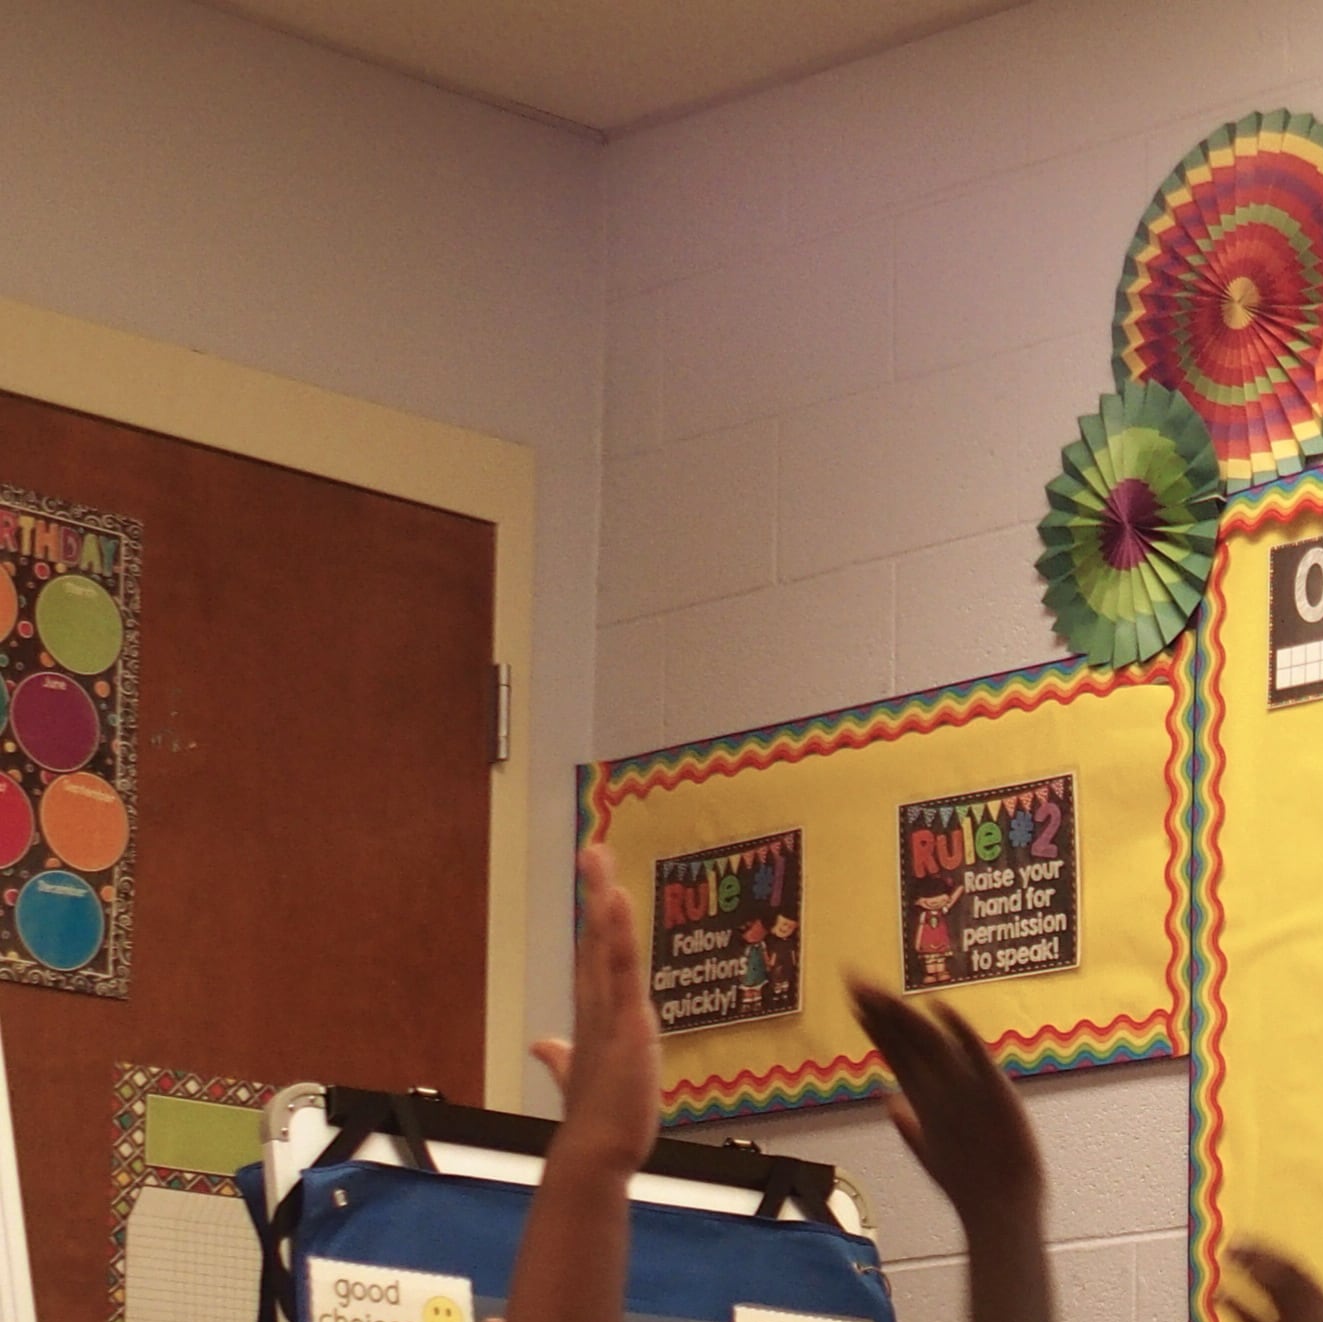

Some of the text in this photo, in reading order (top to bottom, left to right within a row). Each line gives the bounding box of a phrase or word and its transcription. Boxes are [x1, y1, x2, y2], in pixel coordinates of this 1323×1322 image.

[0, 509, 119, 577] RTHDAY
[912, 801, 1061, 878] Rule #2
[663, 854, 786, 929] Rule #1
[964, 860, 1064, 893] Raise your
[973, 887, 1056, 919] hand for
[673, 929, 732, 957] Follow
[963, 911, 1067, 952] permission
[972, 937, 1059, 972] to speak!
[653, 956, 748, 991] directions
[661, 985, 737, 1025] quickly!
[334, 1278, 399, 1308] good
